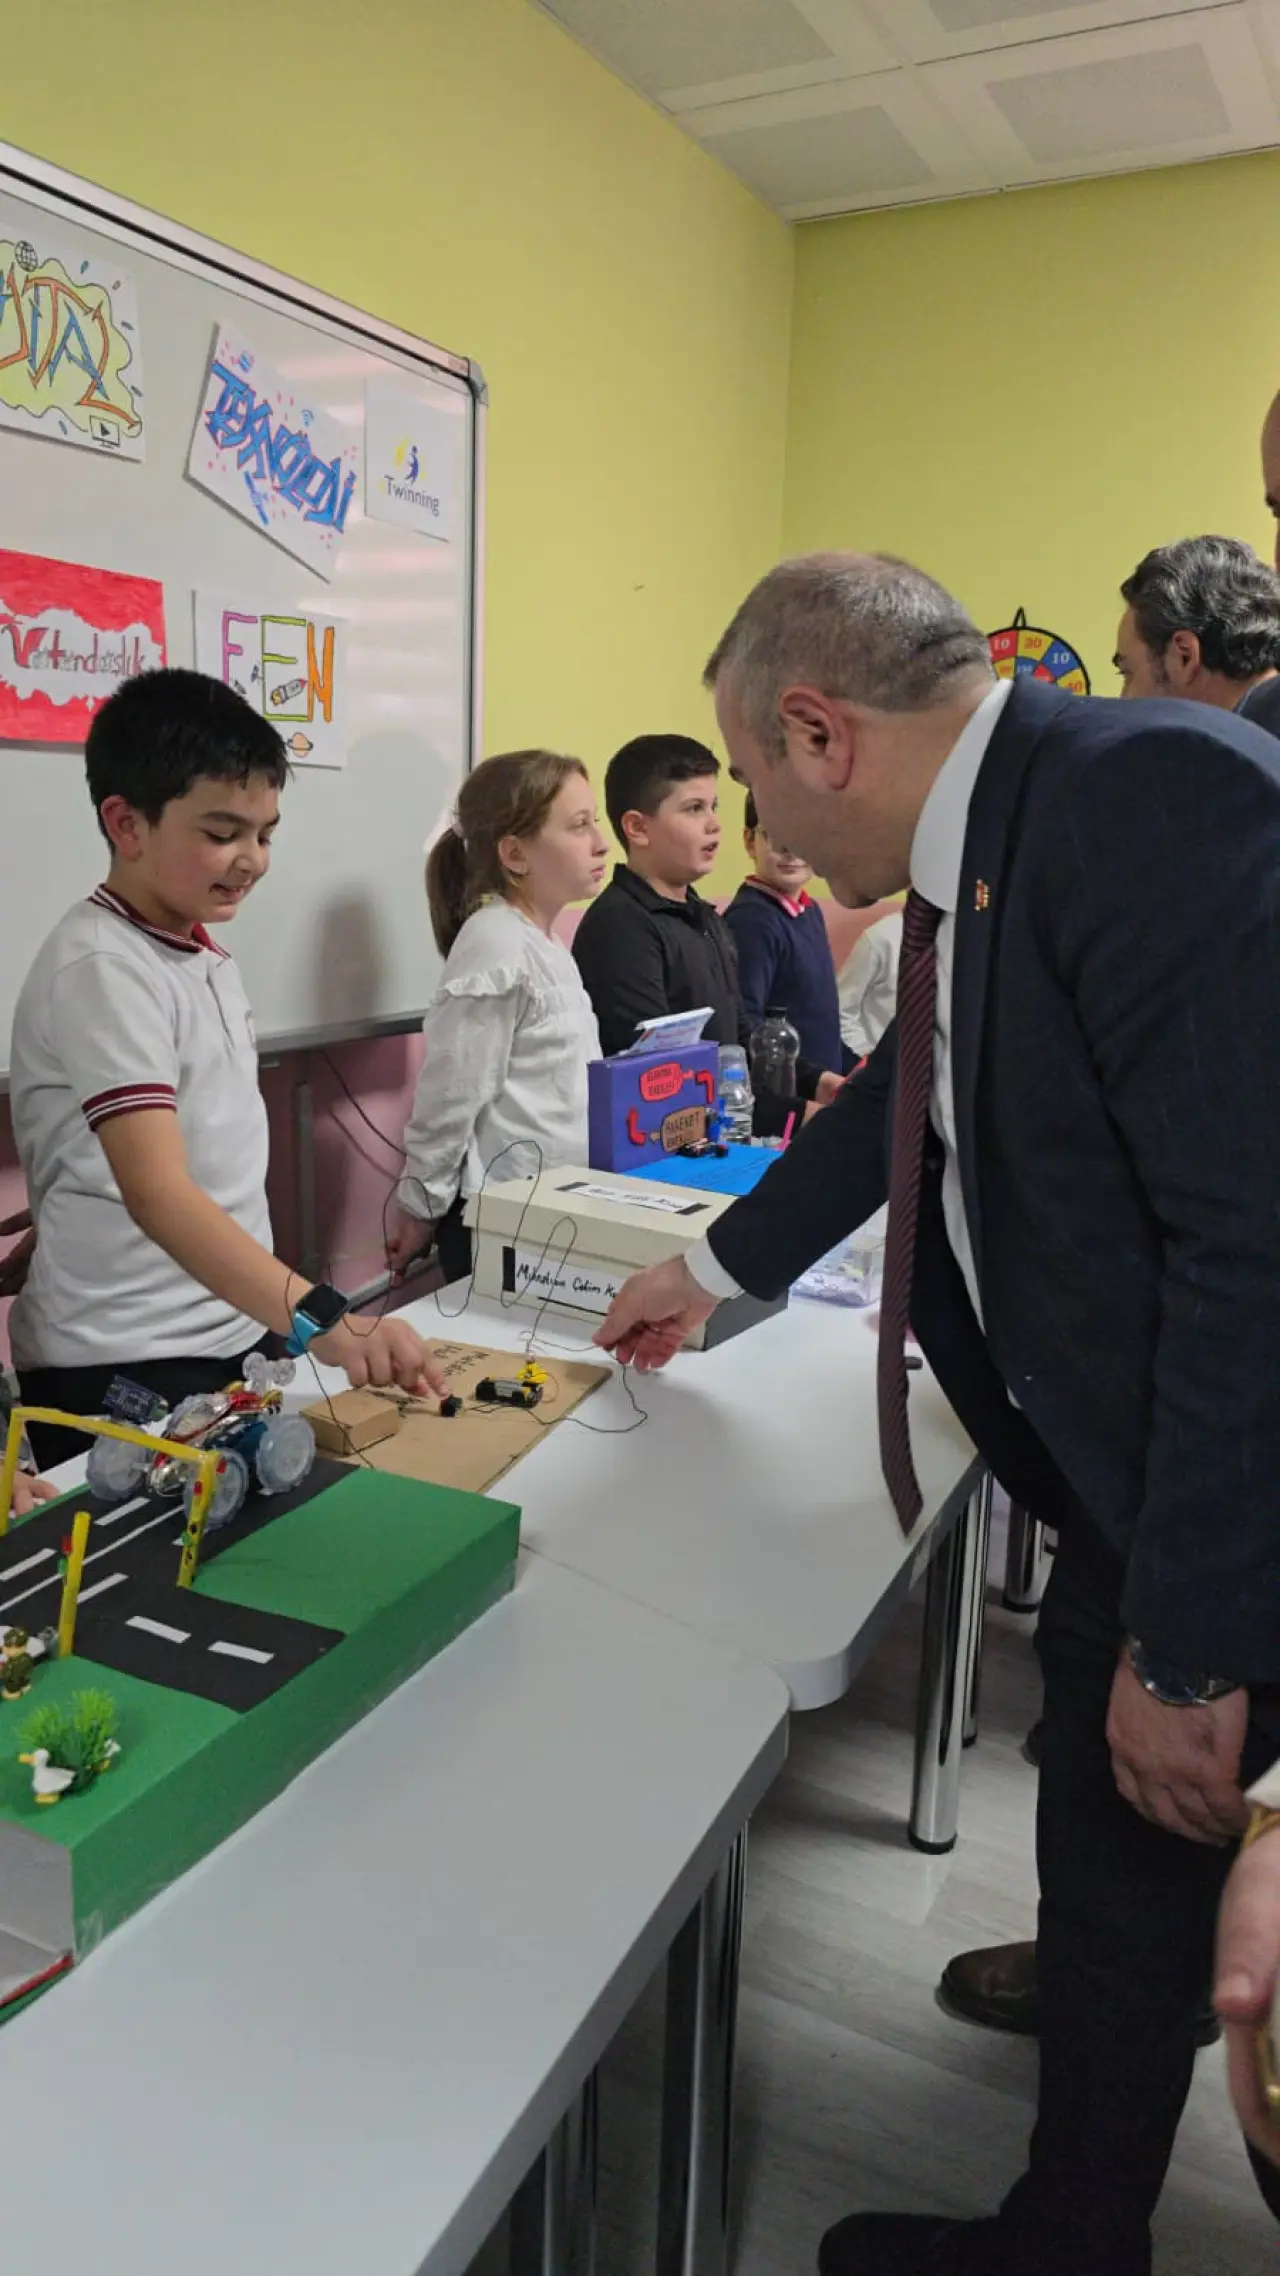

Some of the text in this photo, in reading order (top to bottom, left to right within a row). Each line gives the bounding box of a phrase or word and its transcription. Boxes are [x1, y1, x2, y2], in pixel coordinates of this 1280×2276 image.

[383, 474, 440, 517] Twinning
[993, 637, 1011, 651] 10
[222, 610, 334, 723] FEN
[1053, 653, 1071, 665] 10
